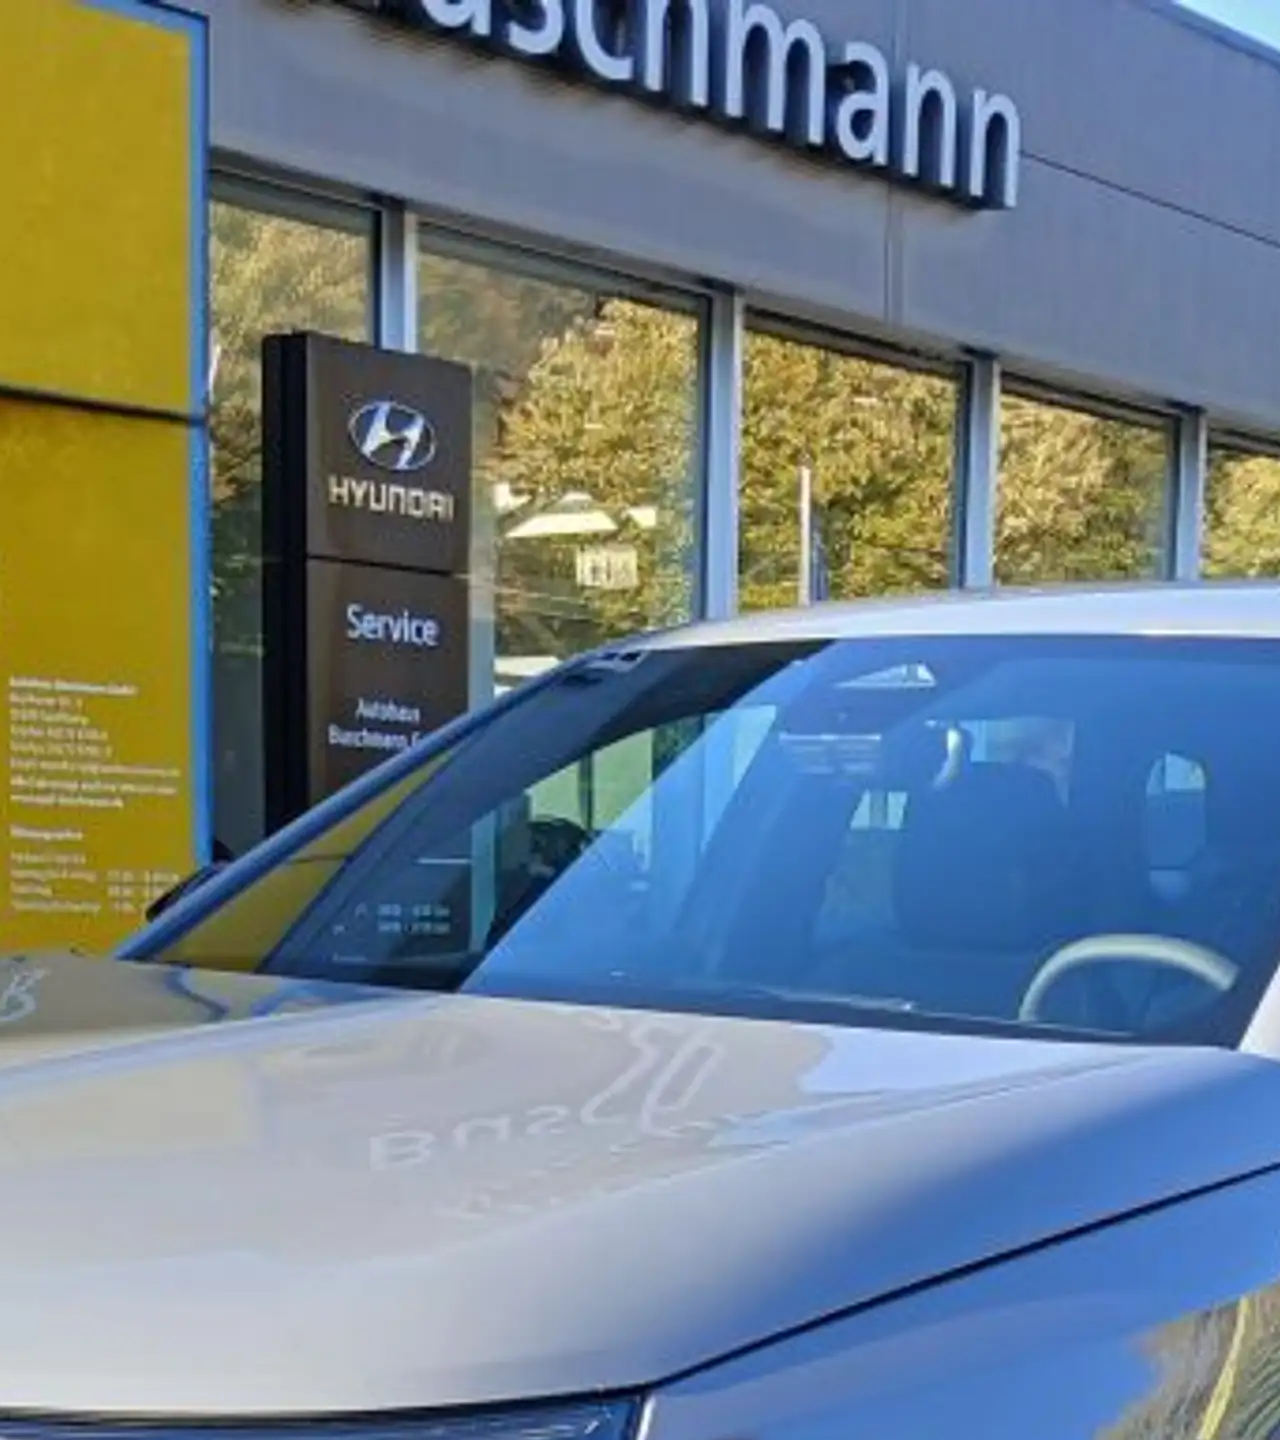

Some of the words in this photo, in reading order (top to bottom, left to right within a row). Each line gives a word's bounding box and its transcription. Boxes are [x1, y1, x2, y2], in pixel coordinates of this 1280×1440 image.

[425, 0, 1018, 208] chmann
[328, 475, 456, 523] HYUNDAI
[346, 603, 440, 647] Service
